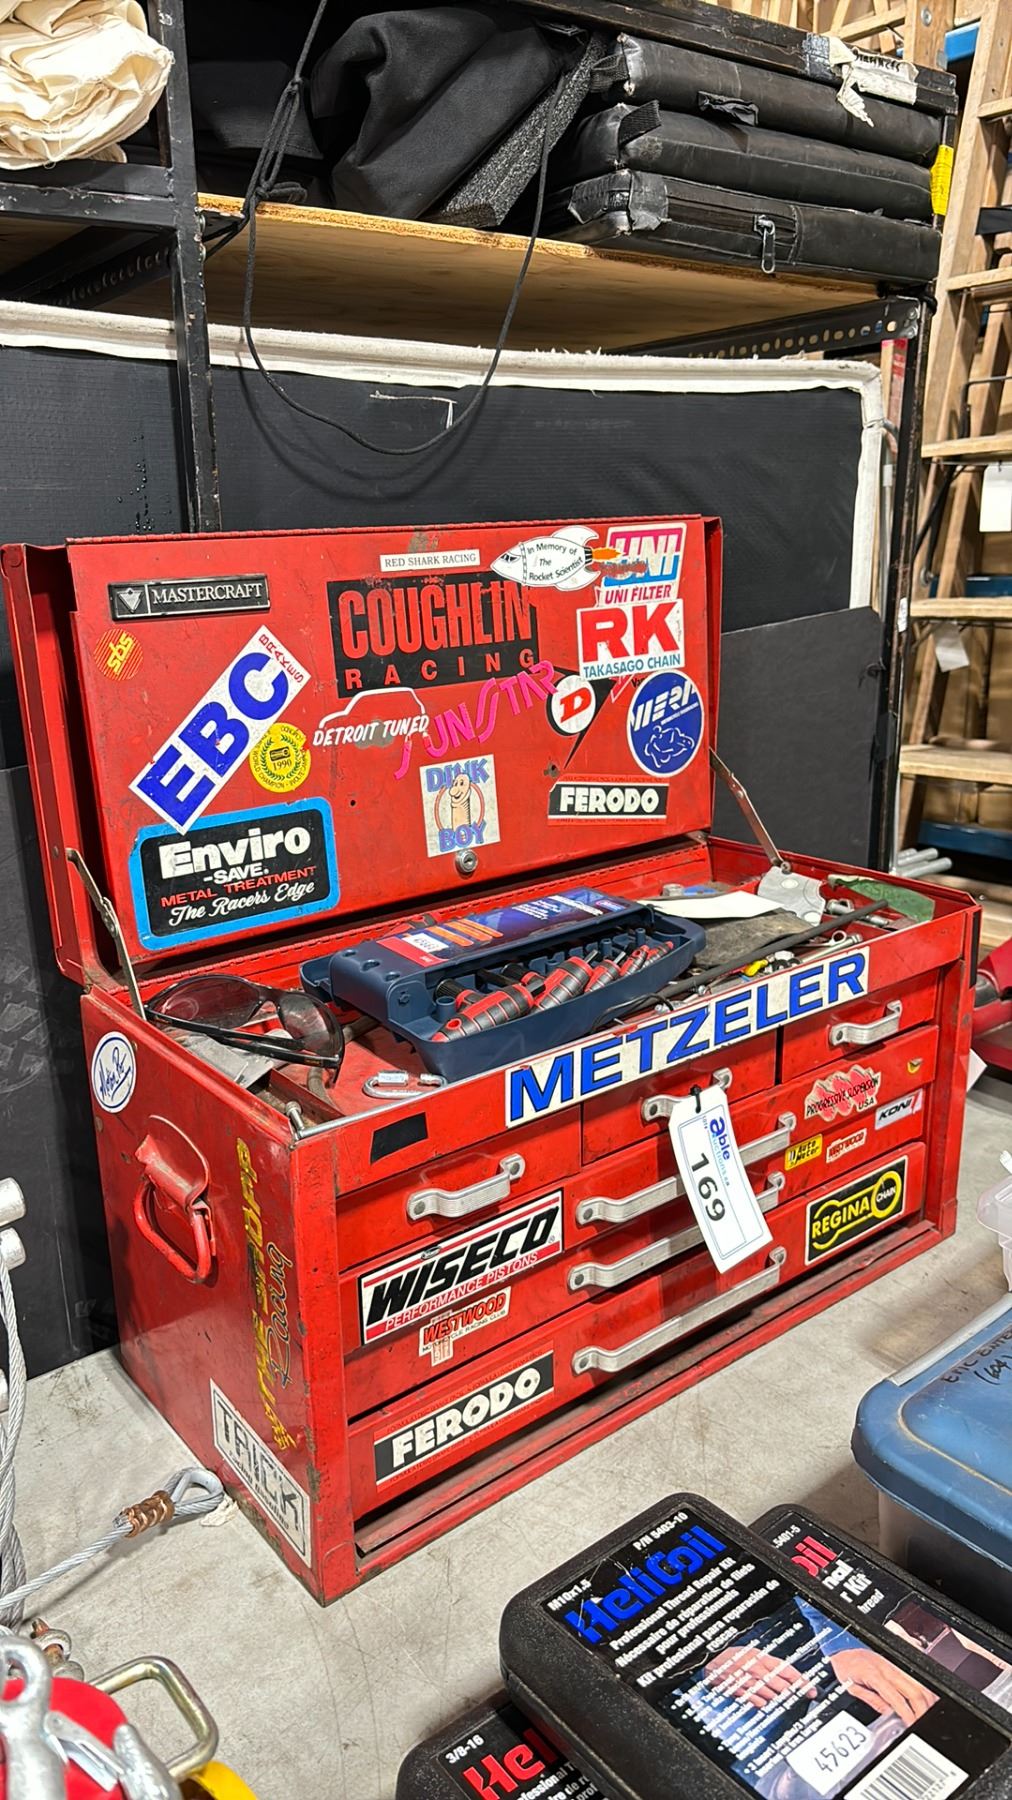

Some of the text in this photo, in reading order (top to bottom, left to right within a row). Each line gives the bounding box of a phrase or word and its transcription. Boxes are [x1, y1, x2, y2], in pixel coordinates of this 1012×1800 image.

[385, 553, 476, 568] RED SHARK RACING
[527, 542, 577, 556] In Memory of
[528, 557, 584, 581] Rocket Scientist
[539, 558, 552, 567] The
[152, 583, 263, 604] MASTERCRAFT
[604, 585, 672, 605] UNI FILTER
[337, 579, 533, 660] COUGHLIN
[579, 602, 680, 663] RK
[258, 633, 304, 683] BRAKES
[344, 647, 536, 691] RACING
[583, 654, 681, 679] TAKASAGO CHAIN
[559, 687, 592, 724] D
[136, 651, 289, 827] EBC
[312, 722, 380, 747] DETROIT
[383, 714, 430, 739] TUNED
[272, 758, 292, 771] 1990
[559, 786, 660, 814] FERODO
[158, 826, 312, 880] Enviro
[438, 819, 487, 854] BOY
[160, 866, 318, 908] METAL TREATMENT
[168, 906, 206, 927] The
[275, 880, 316, 903] Edge
[510, 951, 867, 1122] METZELER
[857, 1096, 875, 1111] USA
[878, 1098, 913, 1121] KONI
[709, 1116, 731, 1161] able
[797, 1139, 817, 1155] Auto
[690, 1152, 727, 1222] 169
[876, 1185, 897, 1203] CHAIN
[811, 1195, 870, 1239] REGINA
[365, 1205, 560, 1328] WISECO
[384, 1251, 539, 1331] PERFORMANCE PISTONS
[266, 1241, 295, 1390] Racing
[423, 1292, 508, 1346] WESTWOOD
[465, 1318, 489, 1332] RACING
[489, 1309, 506, 1321] CLUB
[391, 1367, 542, 1468] FERODO
[217, 1399, 299, 1532] TRICK
[632, 1511, 689, 1551] P/N 5403-10
[547, 1577, 592, 1611] M10x1.5
[564, 1525, 728, 1645] HeliCoil
[609, 1556, 737, 1651] Professional Thread Repair Kit
[664, 1618, 680, 1632] de
[677, 1586, 724, 1624] réparation
[720, 1577, 735, 1590] de
[729, 1562, 756, 1582] filets
[843, 1571, 873, 1597] Kit
[636, 1579, 781, 1687] Kit profesional para reparación de
[655, 1587, 741, 1655] pour professionnels
[705, 1625, 739, 1653] roscas
[445, 1734, 485, 1764] 3/8-16
[814, 1725, 867, 1774] 45623
